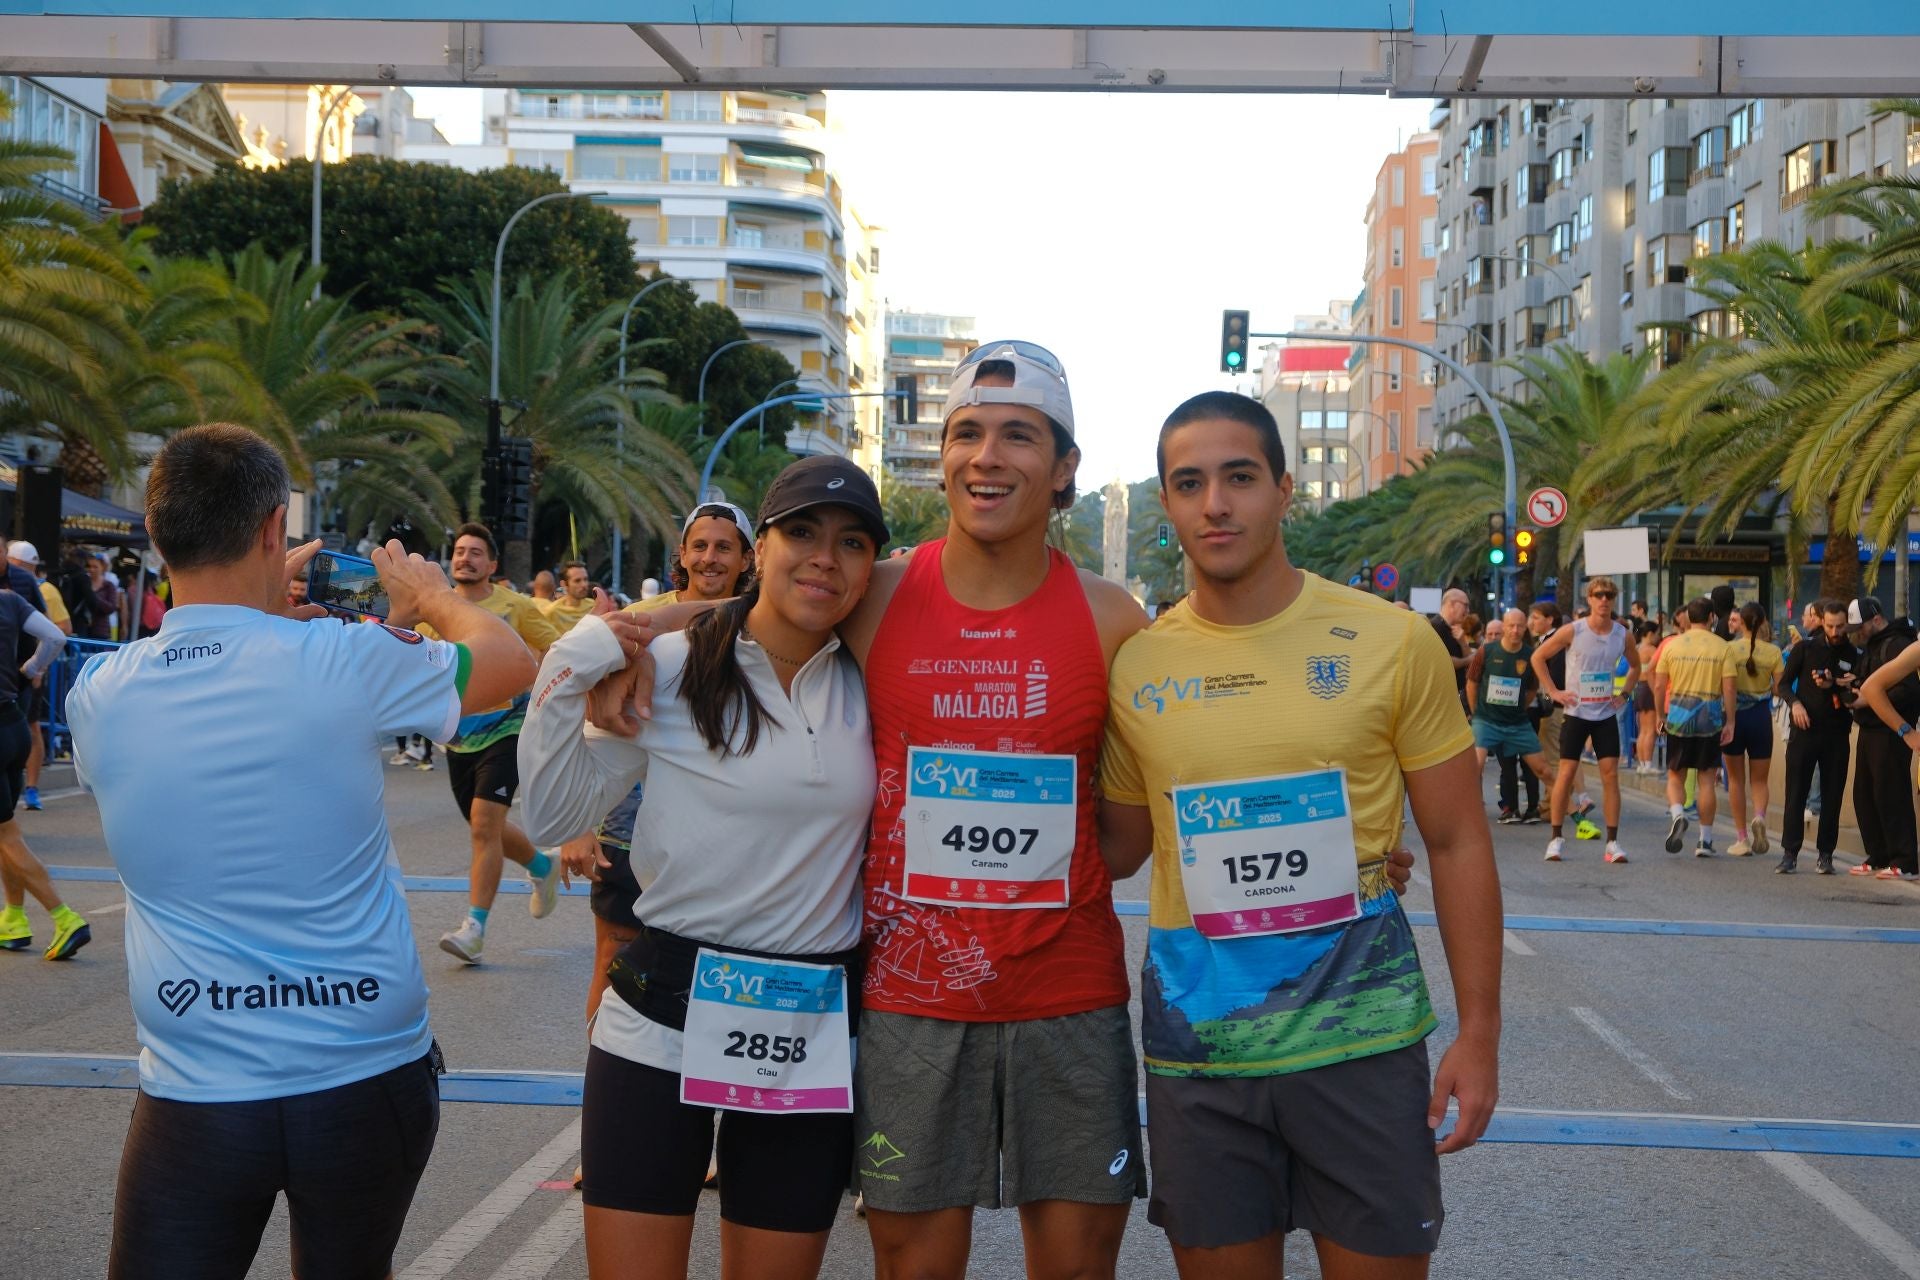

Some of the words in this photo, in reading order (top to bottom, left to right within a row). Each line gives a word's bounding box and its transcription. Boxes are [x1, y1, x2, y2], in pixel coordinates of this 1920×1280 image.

[162, 642, 222, 667] prima
[934, 660, 1018, 675] GENERALI
[1204, 676, 1224, 684] Gran
[932, 689, 1019, 719] MÁLAGA
[953, 767, 978, 788] VI
[992, 789, 1016, 799] 2025
[1216, 797, 1243, 818] VI
[1258, 813, 1282, 825] 2025
[941, 825, 1040, 856] 4907
[971, 859, 1009, 869] Caramo
[1222, 849, 1309, 884] 1579
[1244, 884, 1296, 898] CARDONA
[206, 974, 380, 1011] trainline
[739, 974, 765, 996] VI
[776, 998, 799, 1009] 2025
[723, 1030, 808, 1063] 2858
[757, 1067, 778, 1078] Clau
